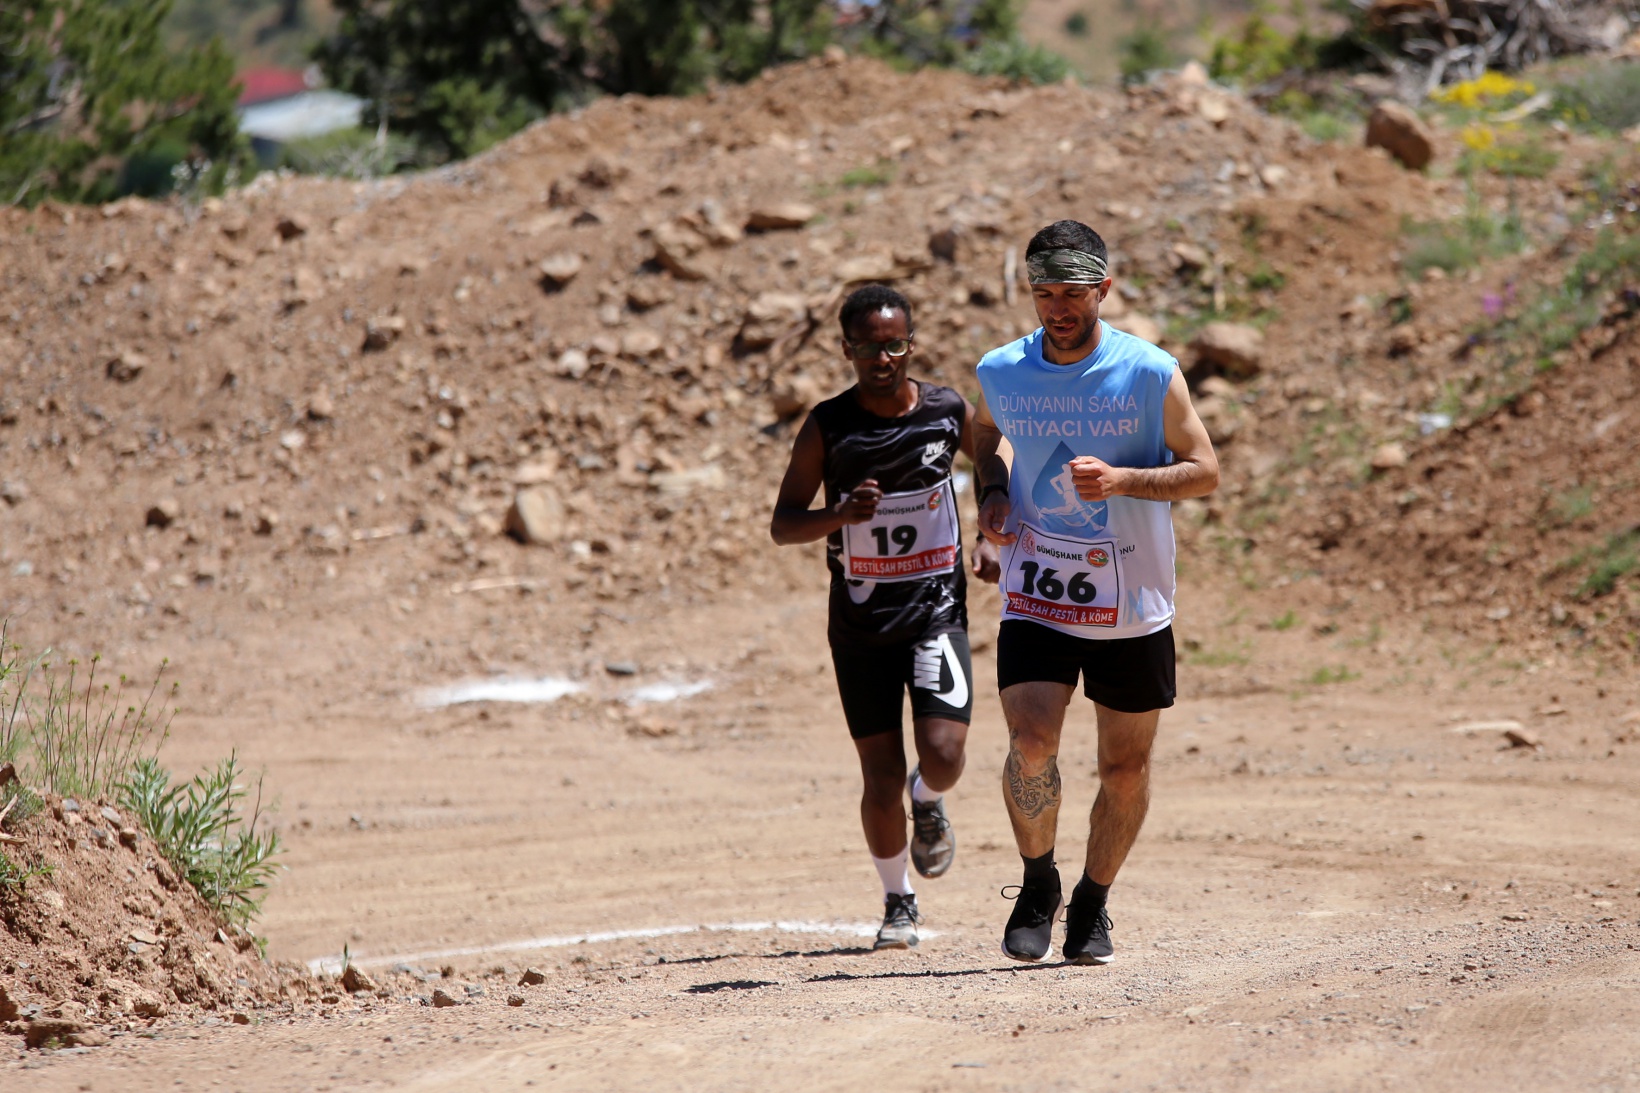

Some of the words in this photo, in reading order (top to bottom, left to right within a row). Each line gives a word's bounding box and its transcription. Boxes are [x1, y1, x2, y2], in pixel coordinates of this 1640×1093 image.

[999, 392, 1083, 413] DÜNYANIN
[1088, 394, 1138, 413] SANA
[1002, 414, 1082, 437] İHTİYACI
[1088, 418, 1139, 437] VAR!
[871, 524, 918, 556] 19
[1036, 544, 1083, 561] GÜMÜŞHANE
[853, 559, 896, 575] PESTİLŞAH
[897, 555, 924, 572] PESTİL
[925, 554, 931, 568] &
[932, 548, 955, 566] KÖME
[1019, 560, 1097, 604] 166
[1050, 607, 1079, 623] PESTİL
[1080, 612, 1087, 623] &
[1088, 609, 1114, 623] KÖME
[914, 639, 942, 692] NIKE
